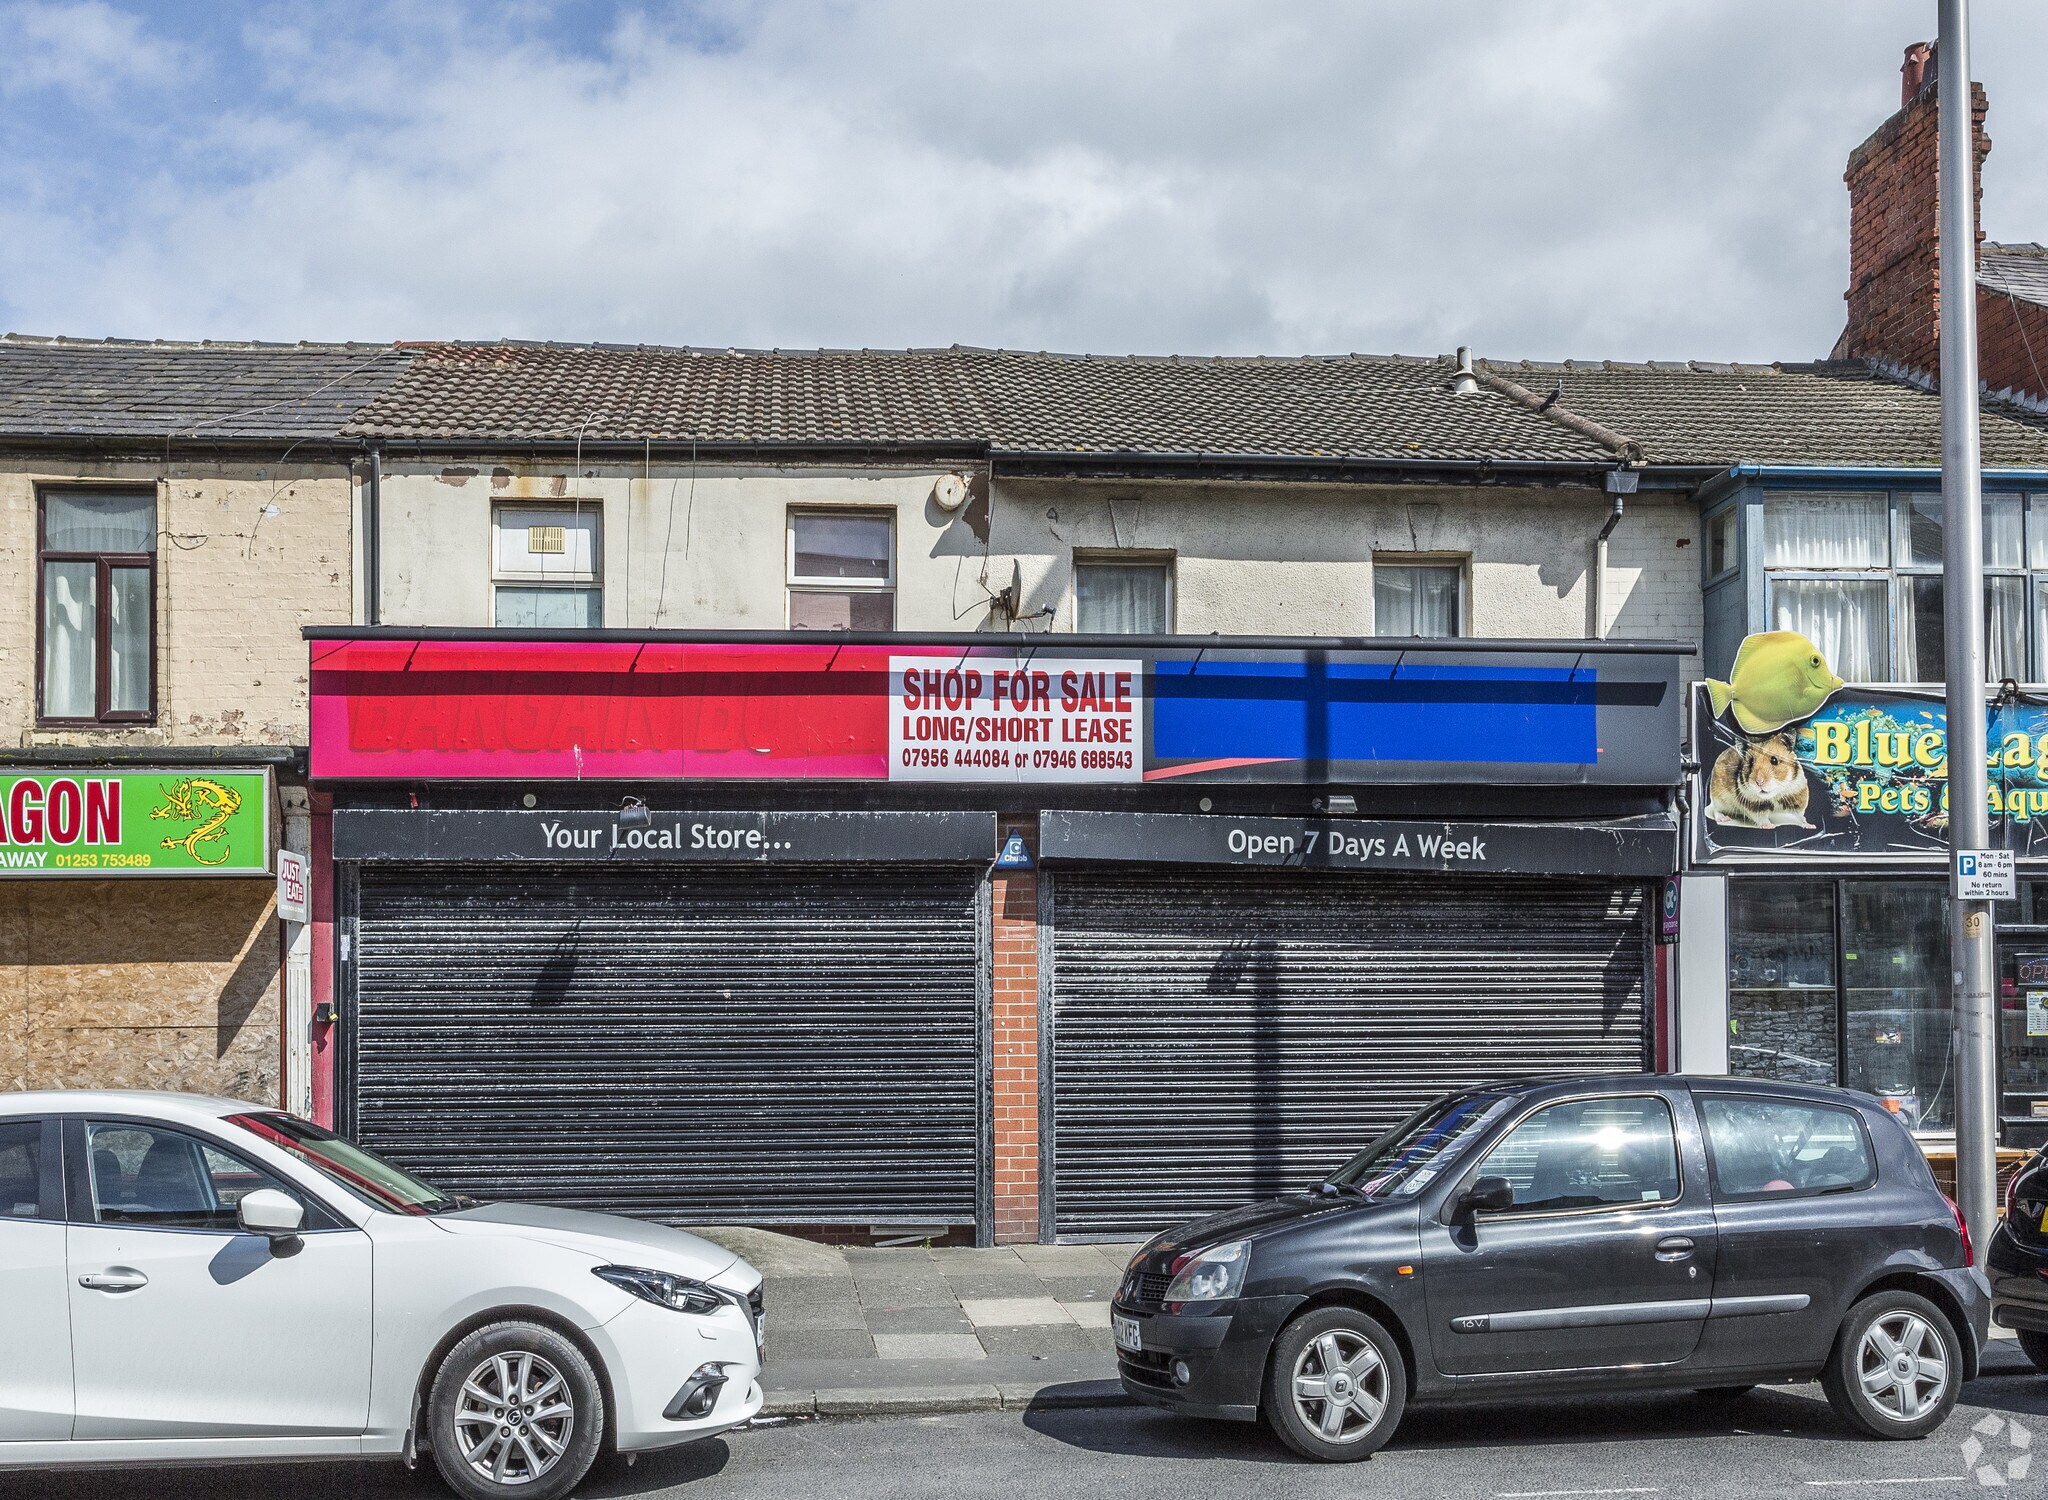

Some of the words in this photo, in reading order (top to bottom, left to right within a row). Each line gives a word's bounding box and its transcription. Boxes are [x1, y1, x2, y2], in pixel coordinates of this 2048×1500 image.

[903, 668, 983, 711] SHOP
[993, 670, 1051, 712] FOR
[1061, 670, 1132, 713] SALE
[902, 715, 1053, 744] LONG/SHORT
[1062, 718, 1132, 743] LEASE
[1813, 719, 1944, 769] Blue
[902, 748, 949, 768] 07956
[954, 748, 1010, 768] 444084
[1014, 753, 1029, 768] or
[1033, 749, 1076, 769] 07946
[1081, 750, 1133, 770] 688543
[1858, 783, 1930, 813] Pets
[0, 778, 122, 846] GON
[540, 822, 602, 849] Your
[612, 822, 682, 849] Local
[691, 823, 792, 849] Store...
[1228, 829, 1294, 859] Open
[1304, 831, 1320, 854] 7
[1329, 831, 1386, 861] Days
[1392, 833, 1411, 857] A
[1417, 834, 1487, 860] Week
[56, 854, 98, 867] 01253
[101, 854, 151, 867] 753489
[282, 858, 300, 882] JUST
[1004, 853, 1028, 862] Chubb
[287, 881, 300, 902] EAT
[1966, 917, 1980, 928] 30
